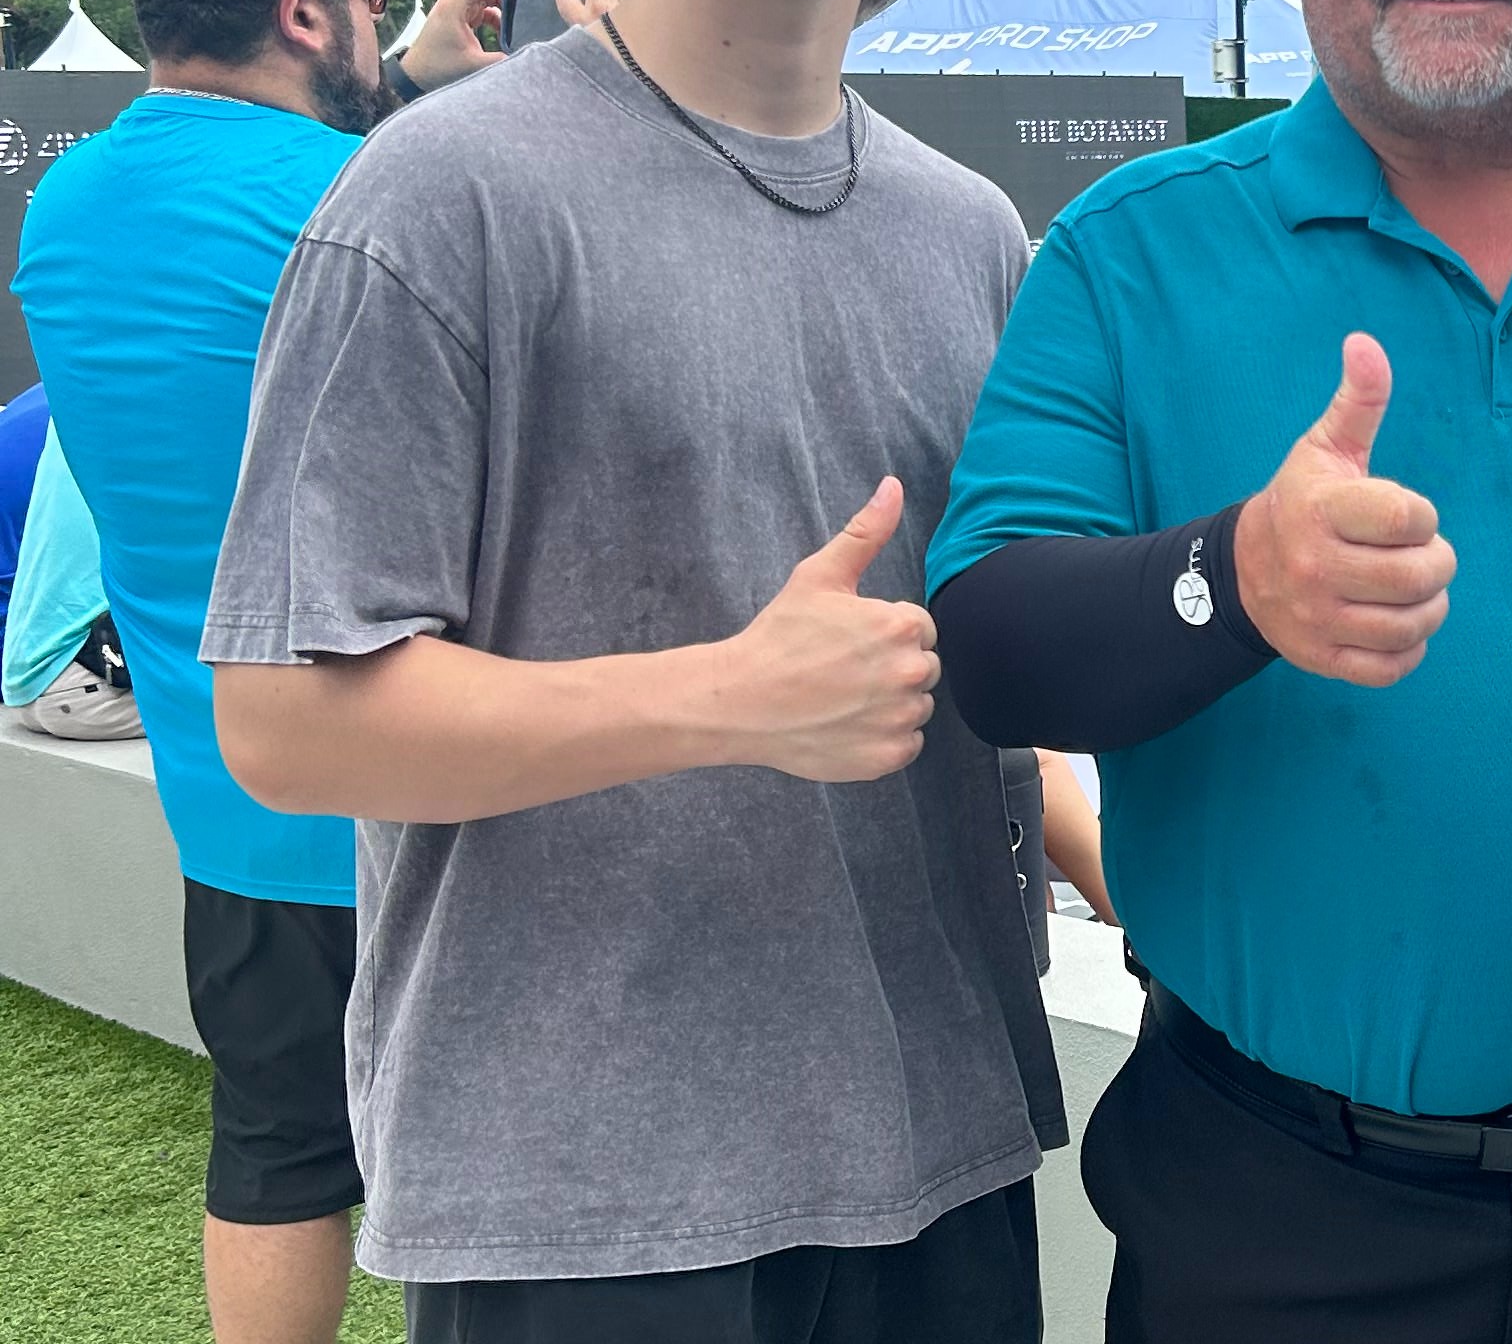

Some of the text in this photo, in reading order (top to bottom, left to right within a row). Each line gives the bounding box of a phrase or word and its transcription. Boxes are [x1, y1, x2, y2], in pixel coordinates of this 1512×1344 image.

[856, 22, 1159, 55] APP PRO SHOP
[1067, 120, 1168, 143] BOTANIST
